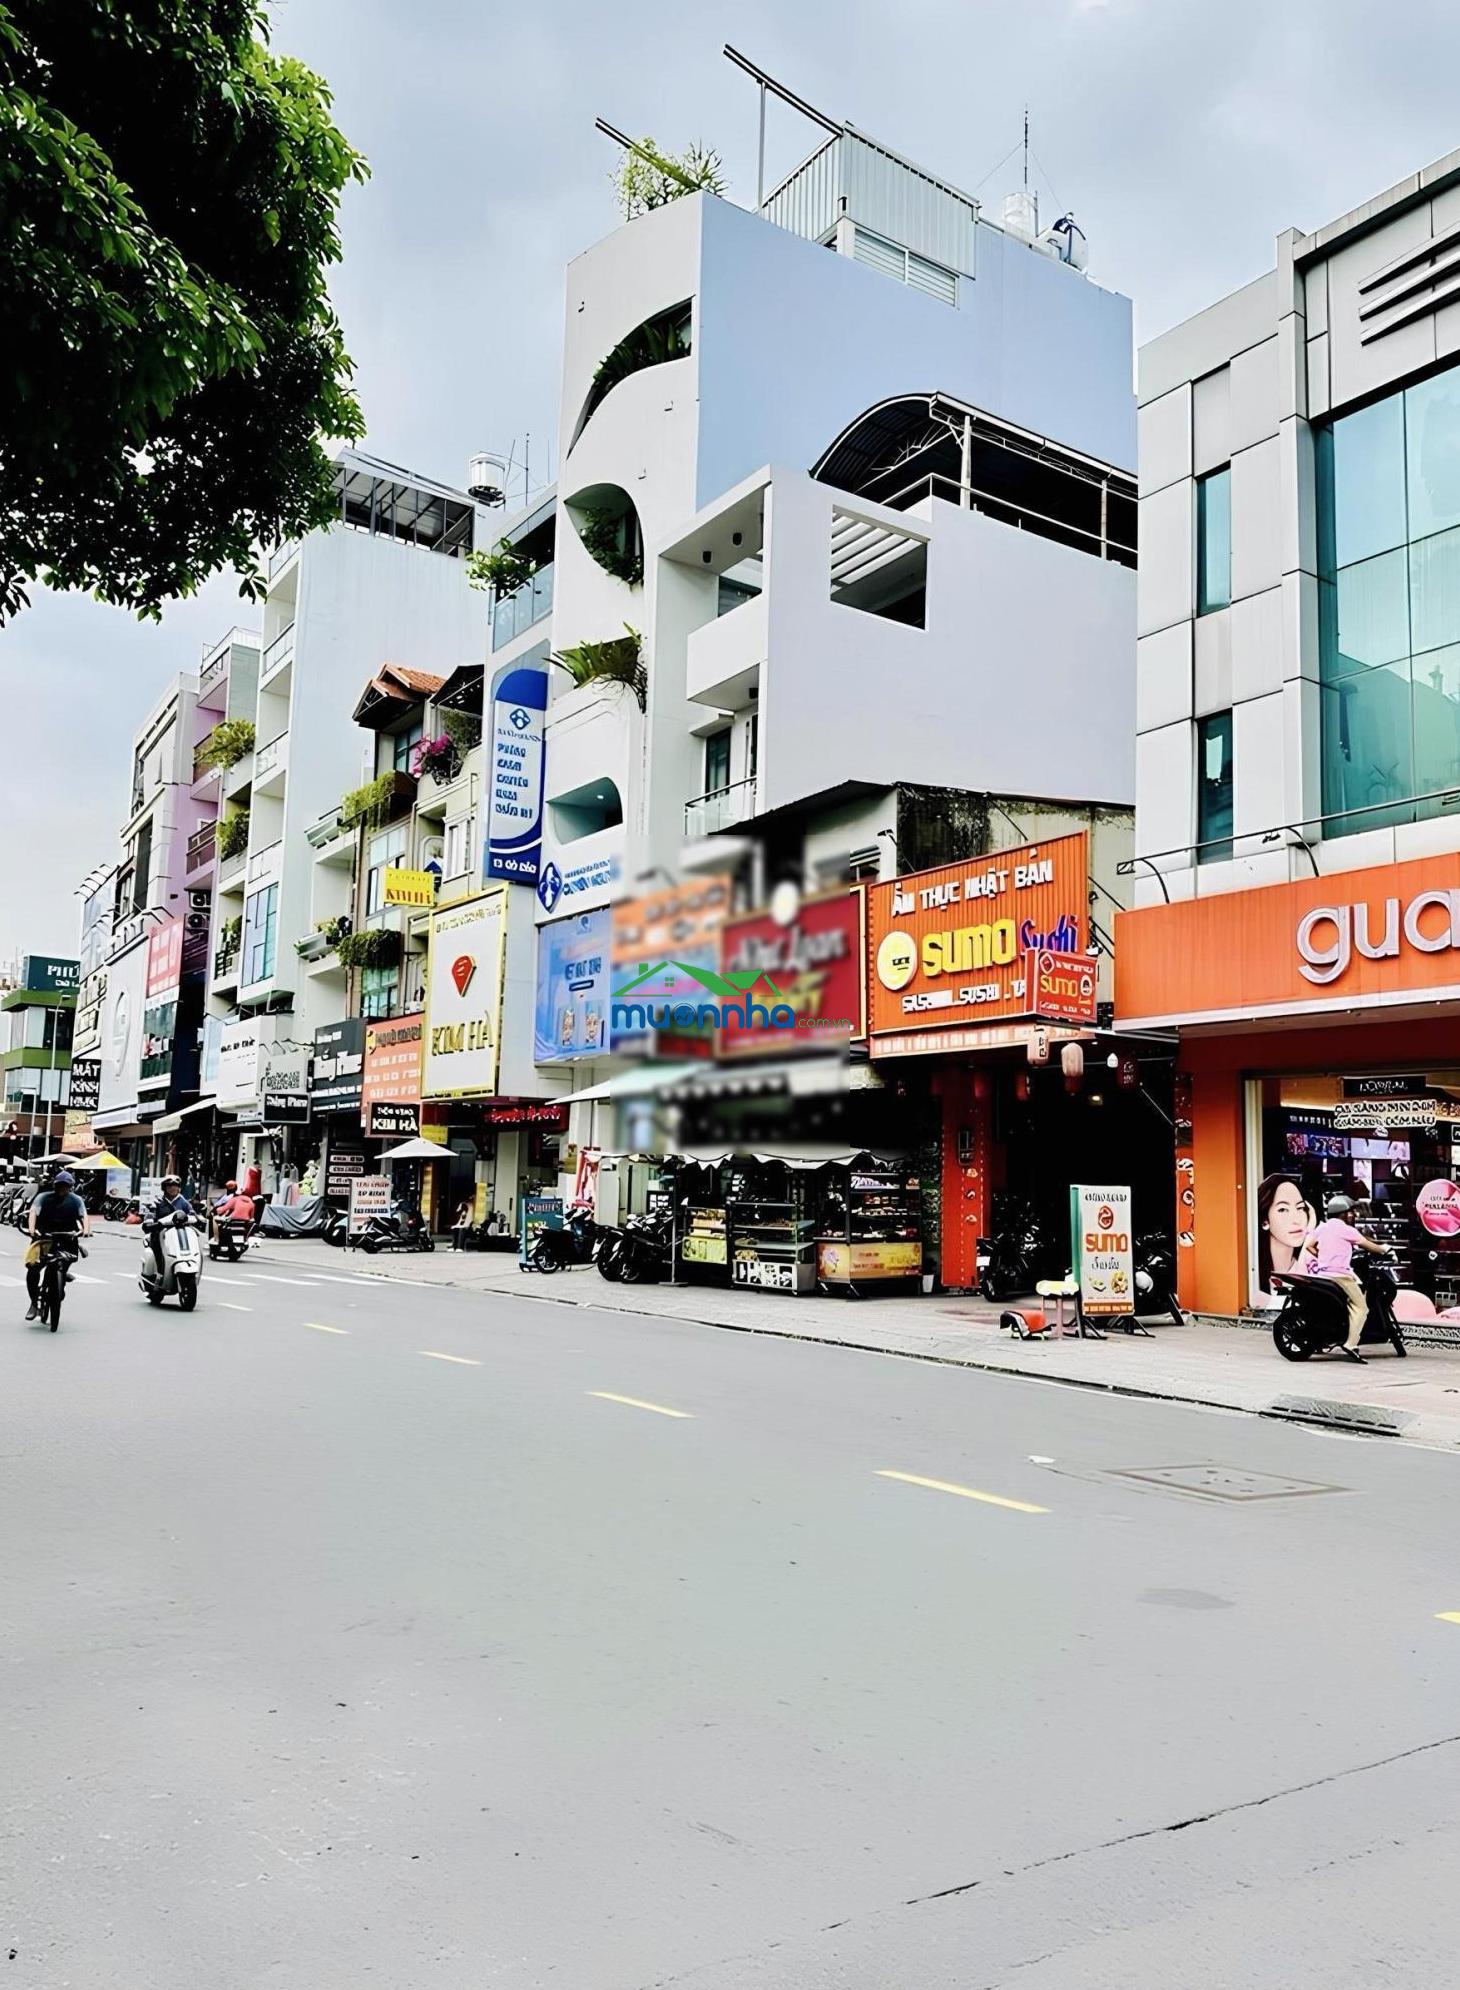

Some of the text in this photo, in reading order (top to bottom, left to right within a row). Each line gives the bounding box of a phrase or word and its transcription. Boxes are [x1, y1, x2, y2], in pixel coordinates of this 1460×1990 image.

[920, 882, 961, 910] THỰC
[1015, 848, 1054, 889] BẢN
[432, 1022, 465, 1057] KIM
[467, 1010, 494, 1051] HÀ
[372, 1116, 419, 1131] KIM HÀ
